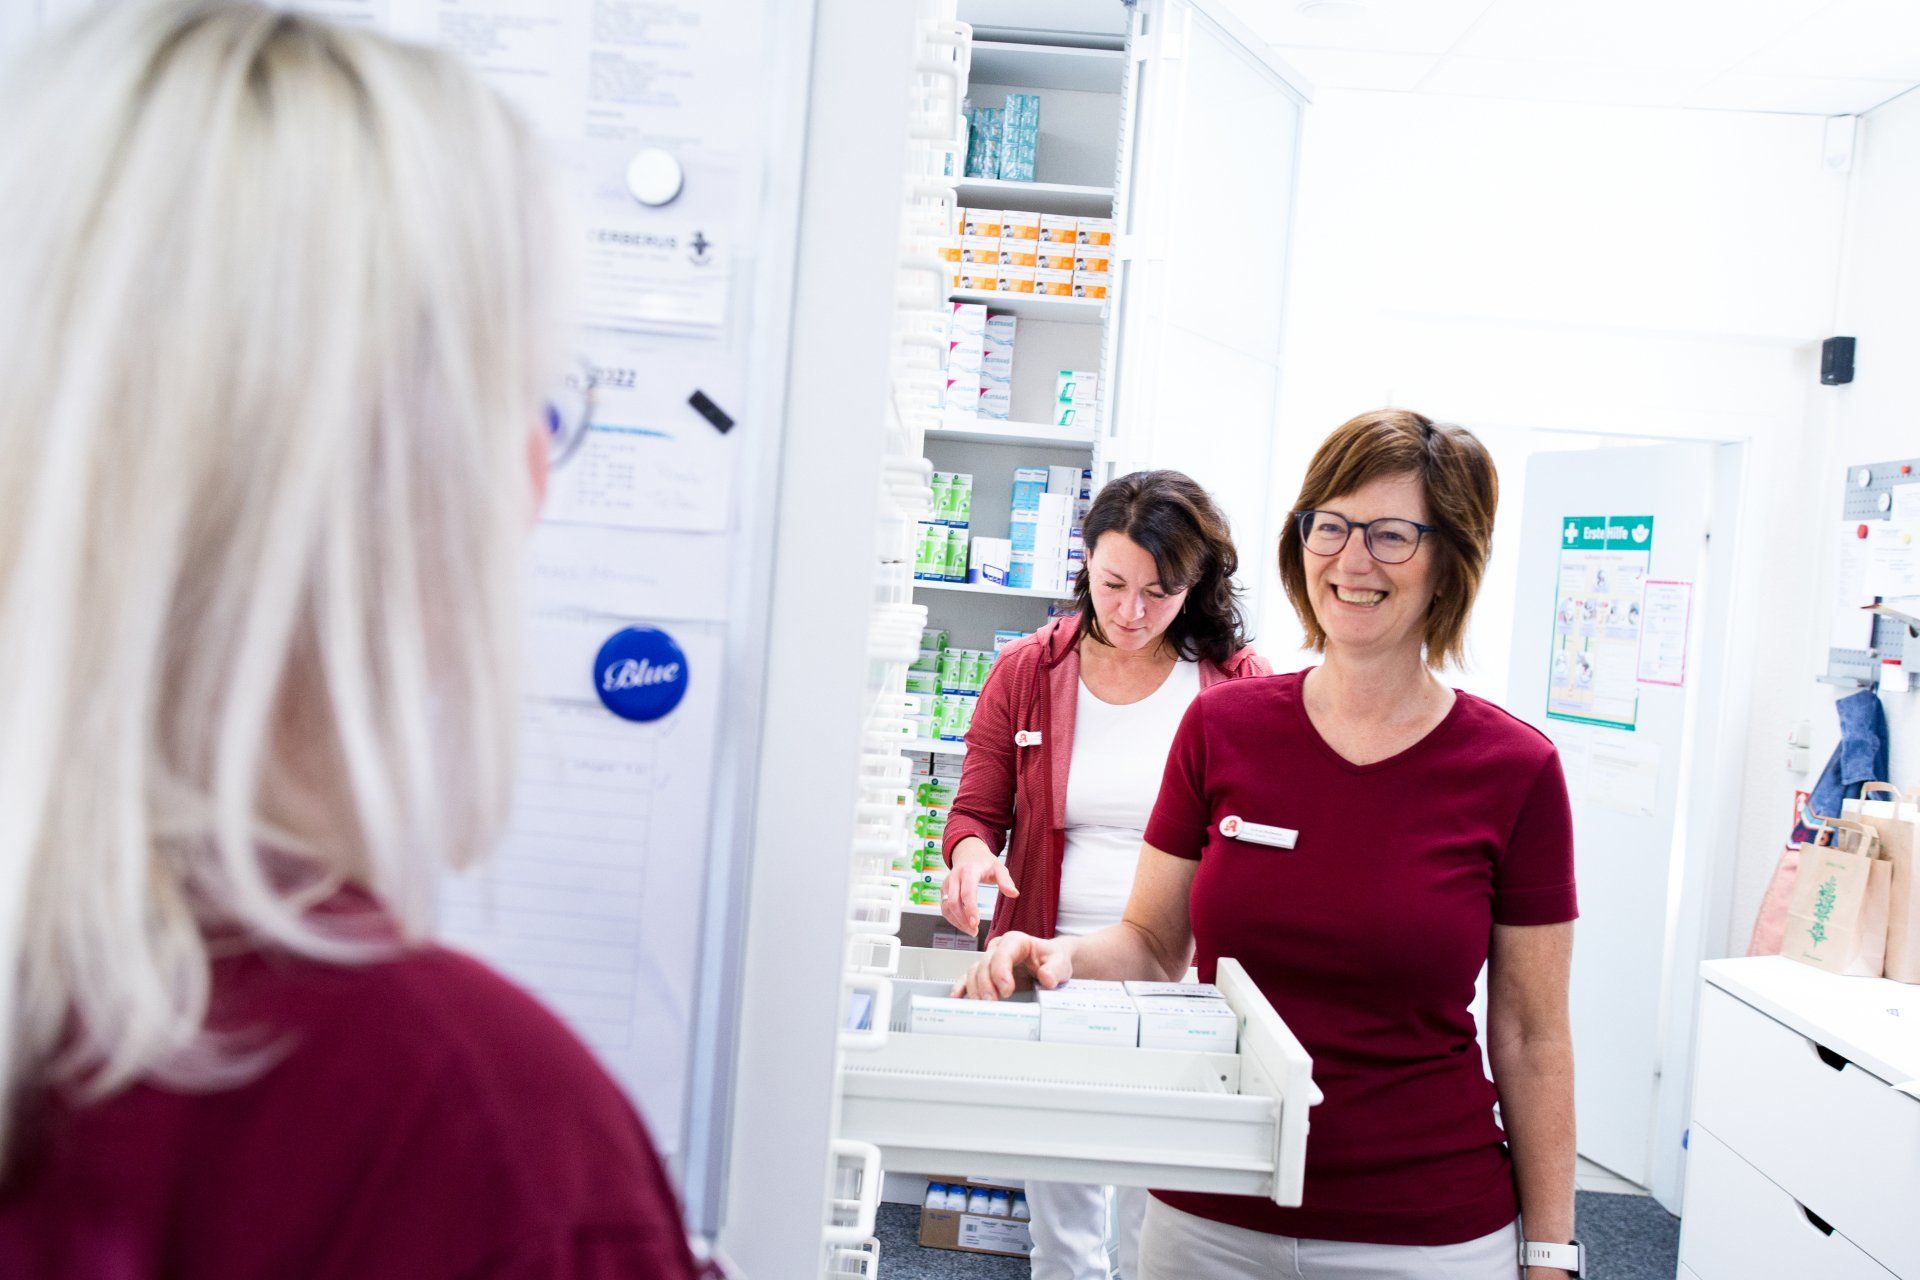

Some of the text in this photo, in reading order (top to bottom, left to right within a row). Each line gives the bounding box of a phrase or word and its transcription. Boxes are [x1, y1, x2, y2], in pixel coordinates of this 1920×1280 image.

[1583, 525, 1629, 540] Erste Hilfe
[602, 657, 681, 694] Blue
